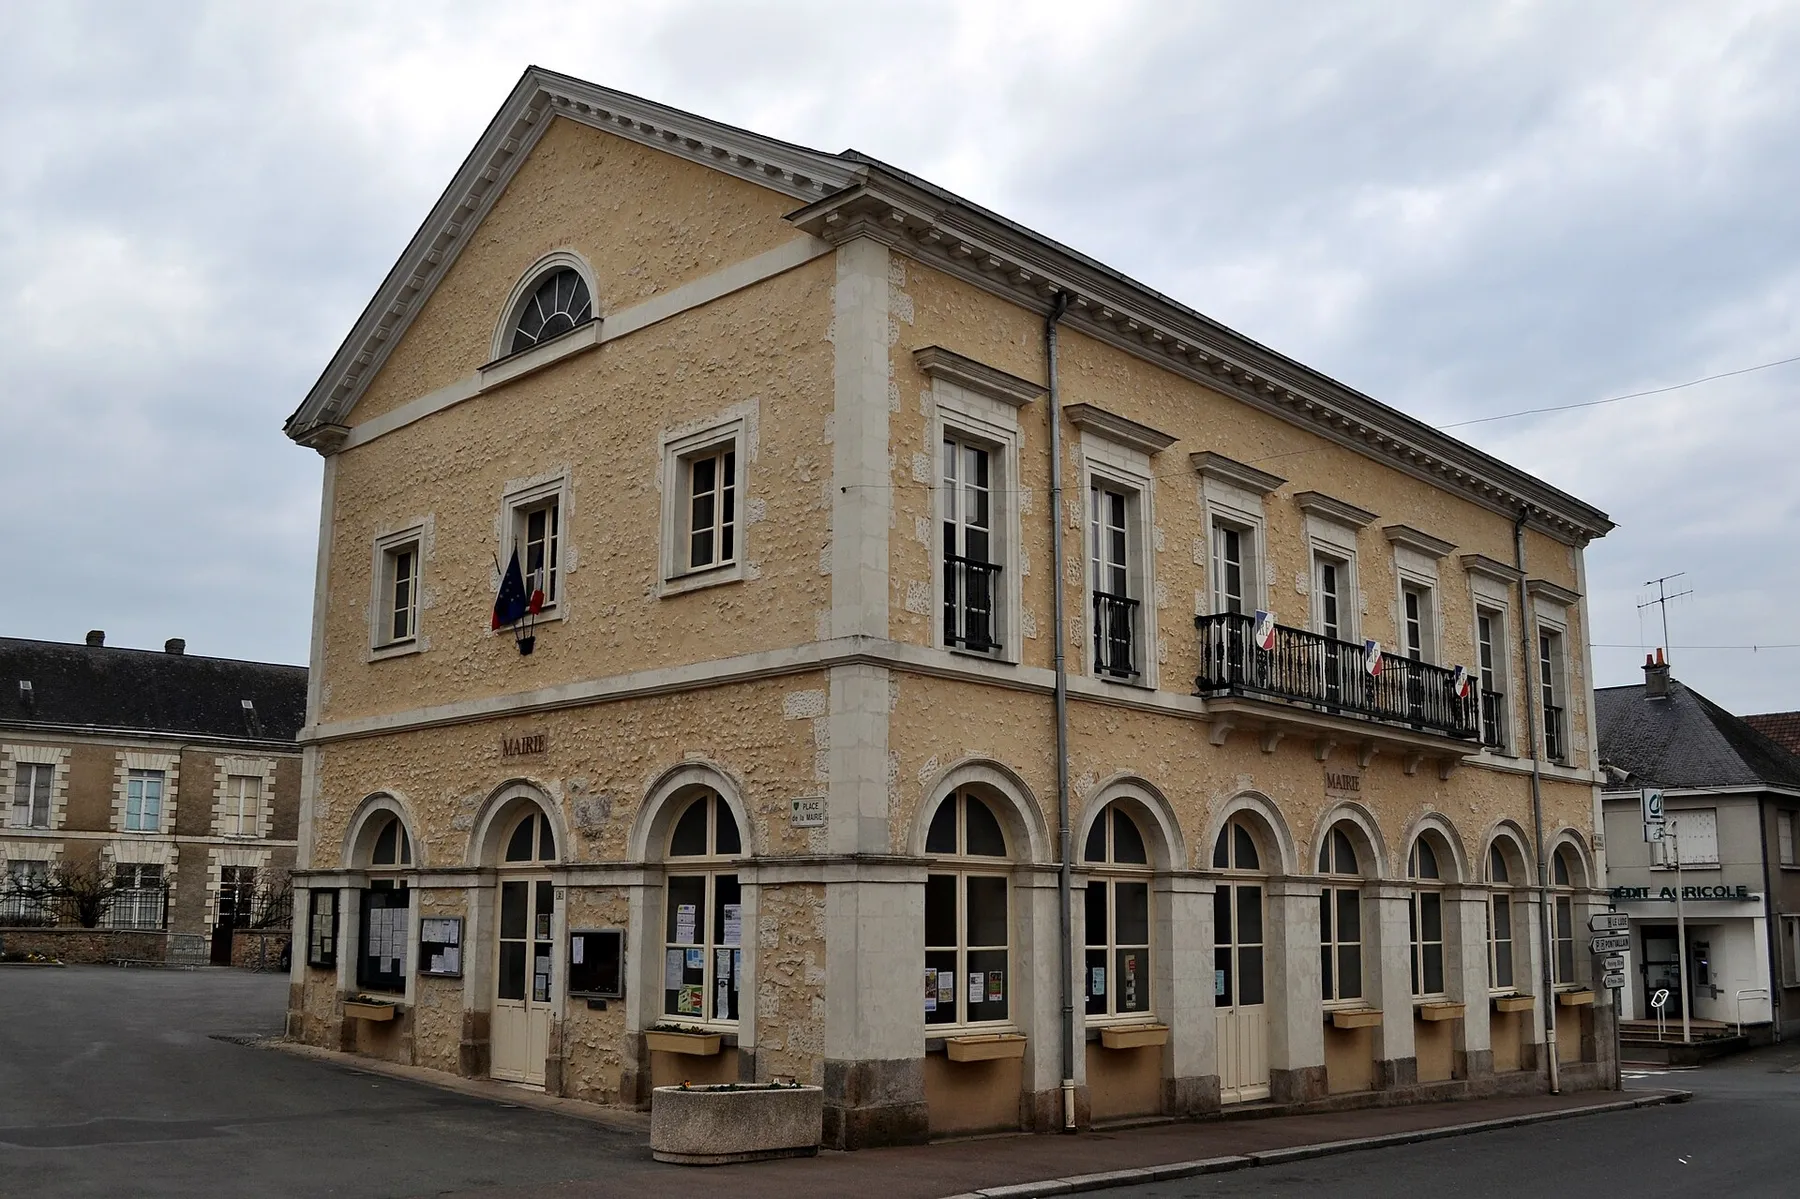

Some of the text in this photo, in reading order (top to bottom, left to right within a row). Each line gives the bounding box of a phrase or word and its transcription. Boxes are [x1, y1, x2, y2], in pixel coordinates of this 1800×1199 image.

[503, 735, 545, 757] MAIRIE
[1326, 772, 1360, 791] MAIRIE
[803, 802, 819, 810] PLACE
[1660, 885, 1748, 898] AGRICOLE
